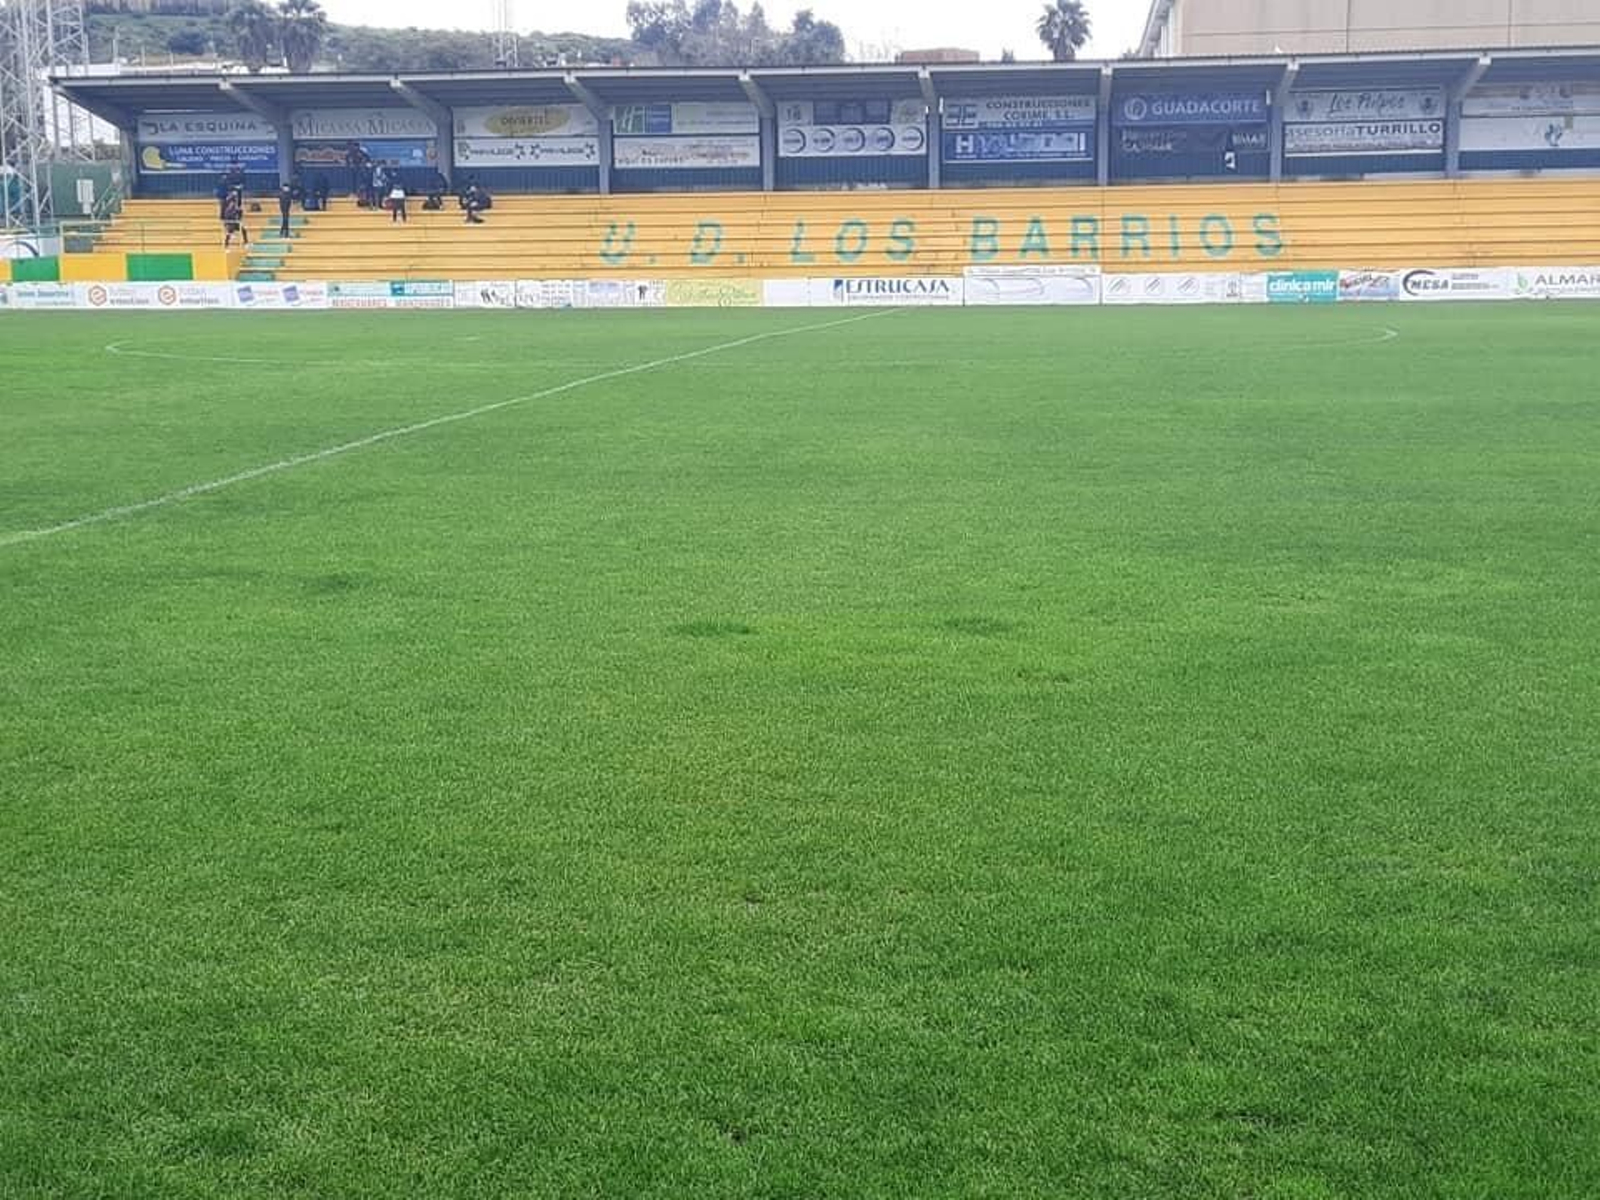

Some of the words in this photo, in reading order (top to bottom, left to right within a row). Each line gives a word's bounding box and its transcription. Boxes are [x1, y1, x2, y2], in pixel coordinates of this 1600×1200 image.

[1151, 99, 1260, 114] GUADACORTE
[1356, 122, 1441, 136] TURRILLO
[790, 218, 917, 263] LOS
[970, 213, 1284, 262] BARRIOS
[845, 279, 950, 294] ESTRUCASA
